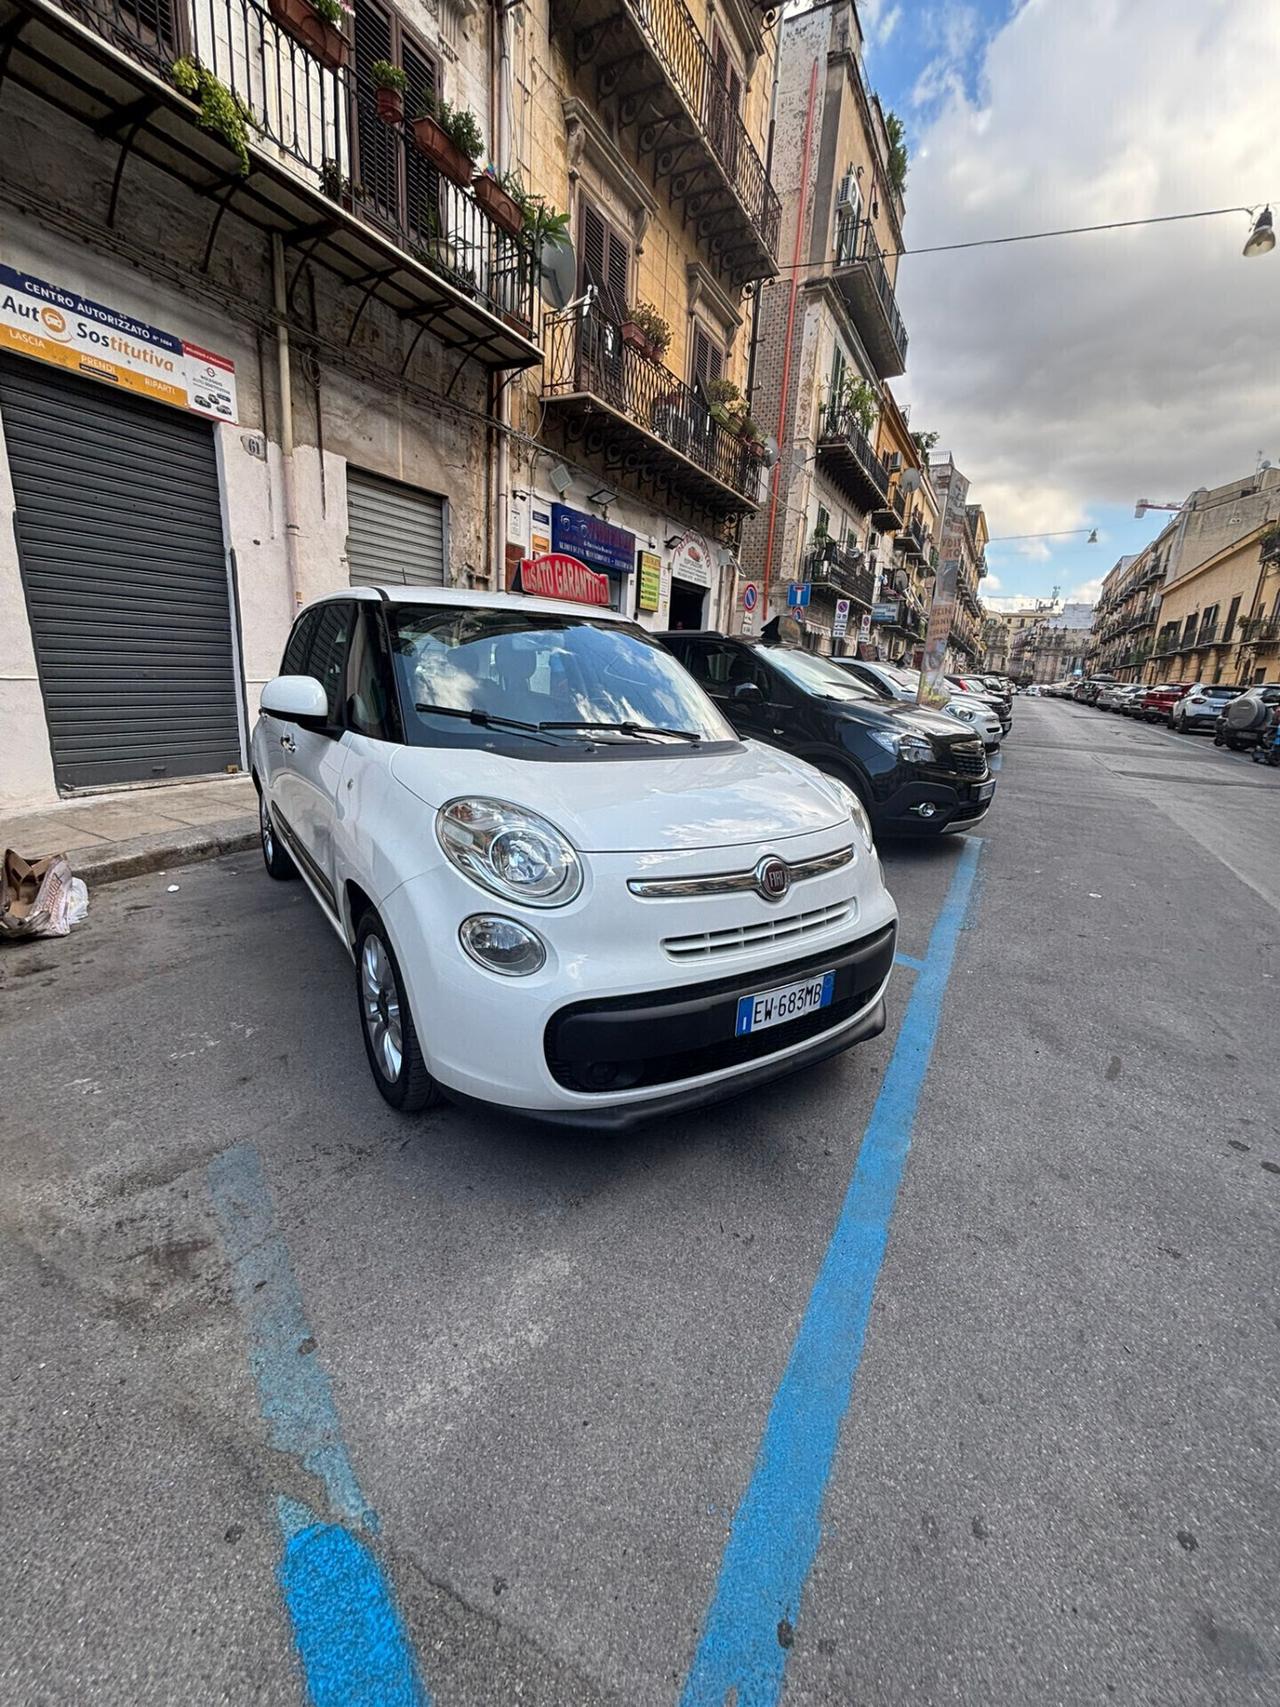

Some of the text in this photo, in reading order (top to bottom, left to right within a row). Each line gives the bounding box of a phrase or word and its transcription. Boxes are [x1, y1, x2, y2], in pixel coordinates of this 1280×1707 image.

[24, 281, 74, 307] CENTRO
[77, 302, 150, 338] AUTORIZZATO
[9, 329, 46, 349] LASCIA
[81, 354, 116, 374] PRENDI
[144, 376, 176, 395] RIPARTI
[76, 322, 174, 372] Sostitutiva
[248, 439, 260, 455] 61
[525, 560, 554, 592] USATO
[555, 559, 608, 602] GARANTITO
[768, 870, 784, 888] FIAT
